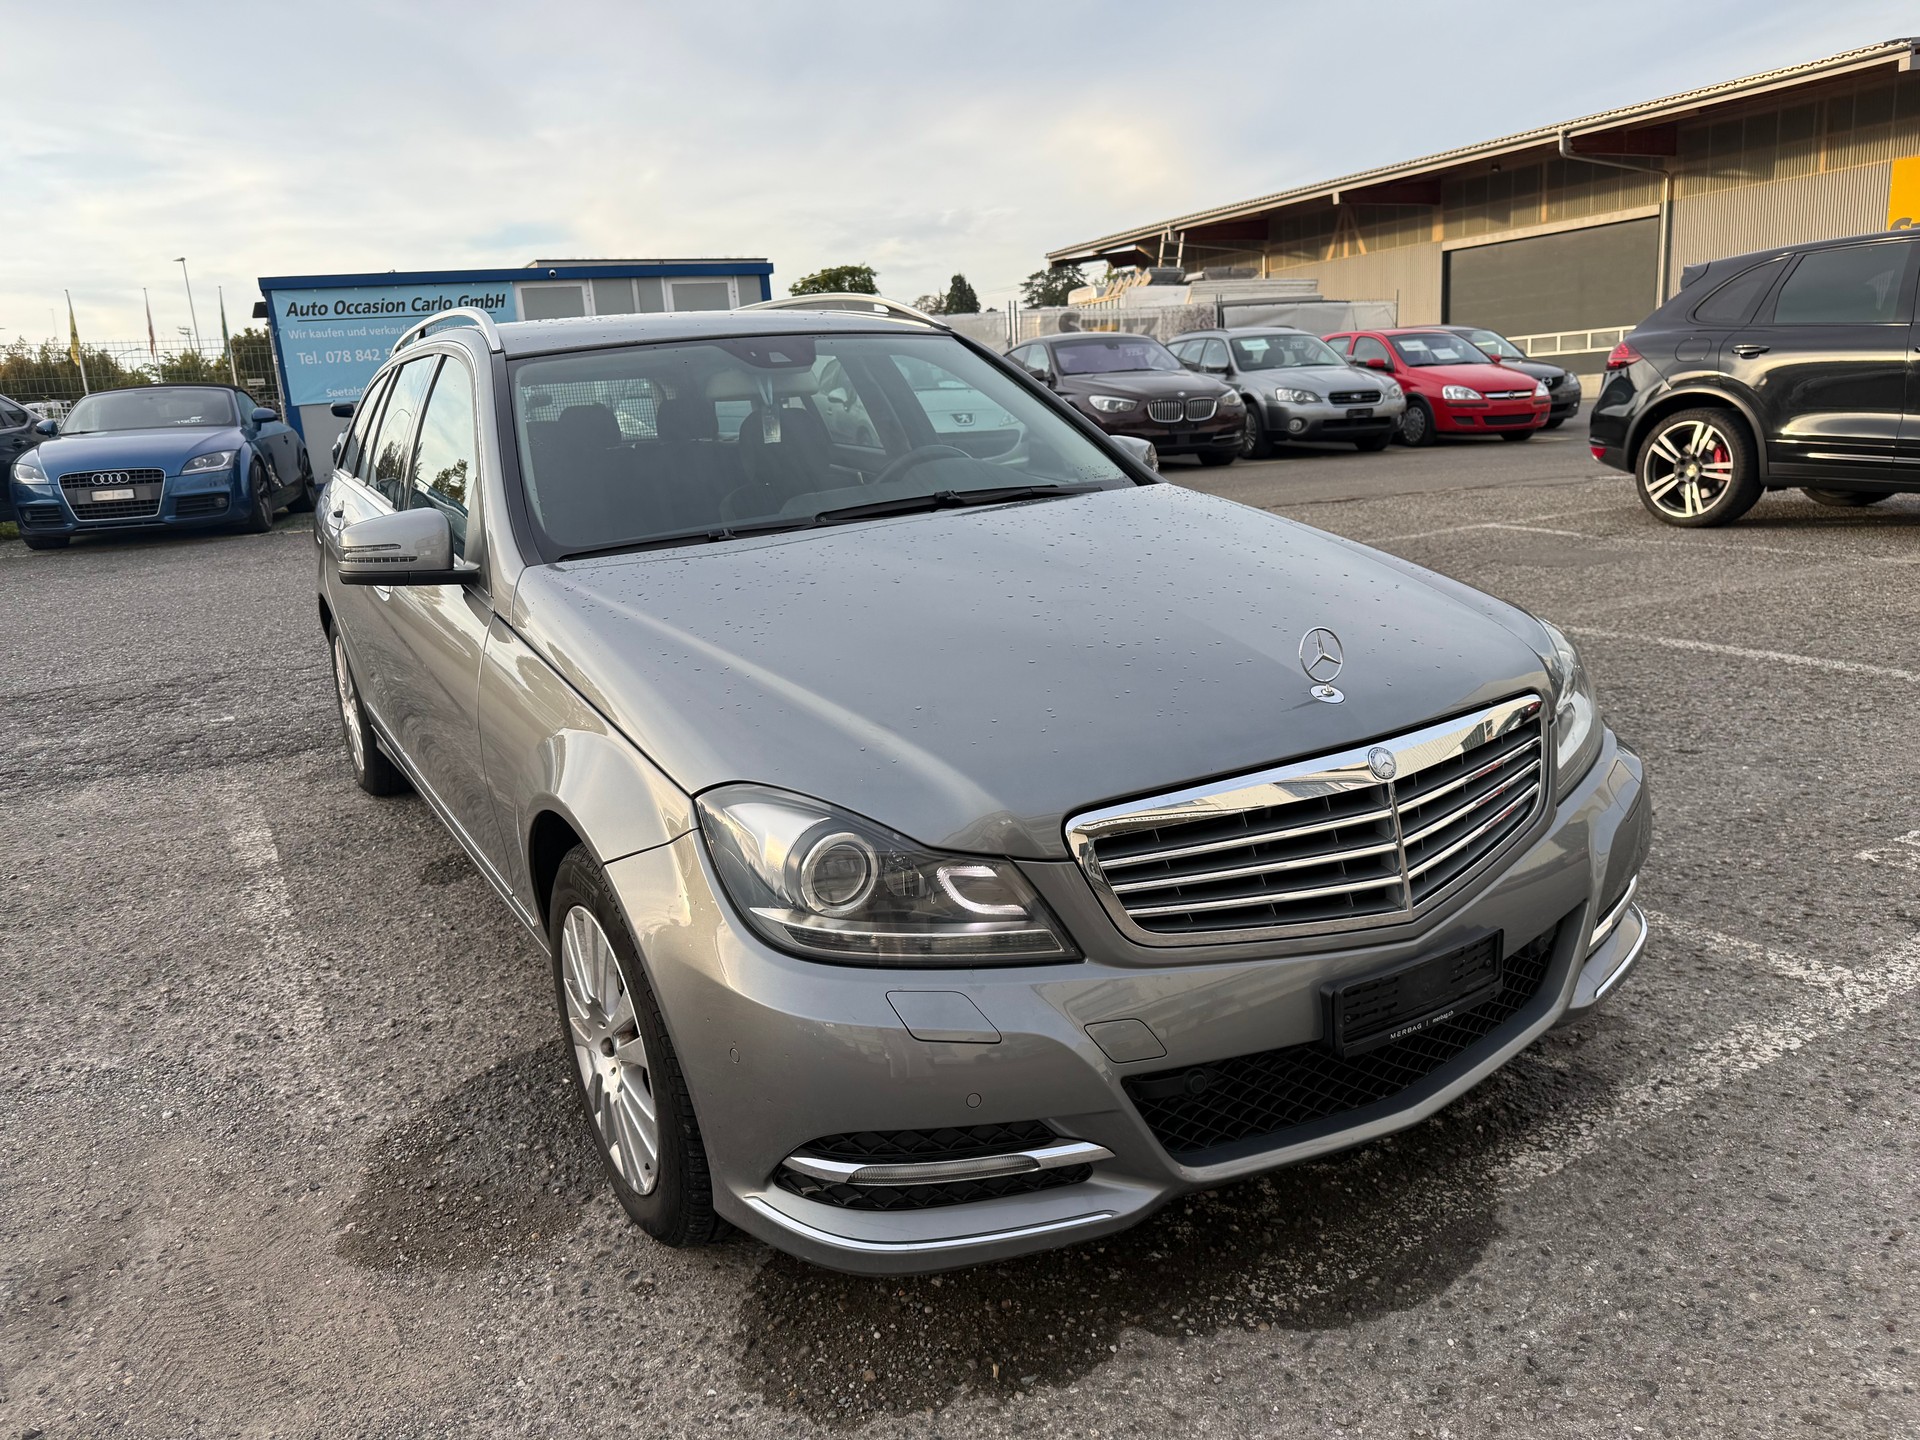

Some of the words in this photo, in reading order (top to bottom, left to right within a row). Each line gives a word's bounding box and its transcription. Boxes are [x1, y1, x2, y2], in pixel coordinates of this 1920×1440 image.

[286, 301, 329, 318] Auto
[333, 298, 406, 316] Occasion
[411, 295, 453, 312] Carlo
[458, 293, 506, 309] GmbH
[287, 329, 307, 340] Wir
[309, 328, 345, 339] kaufen
[347, 326, 367, 337] und
[369, 324, 409, 337] verkauf
[296, 350, 322, 365] Tel.
[325, 350, 352, 364] 078
[355, 348, 381, 362] 842
[1389, 1022, 1422, 1040] MERBAG
